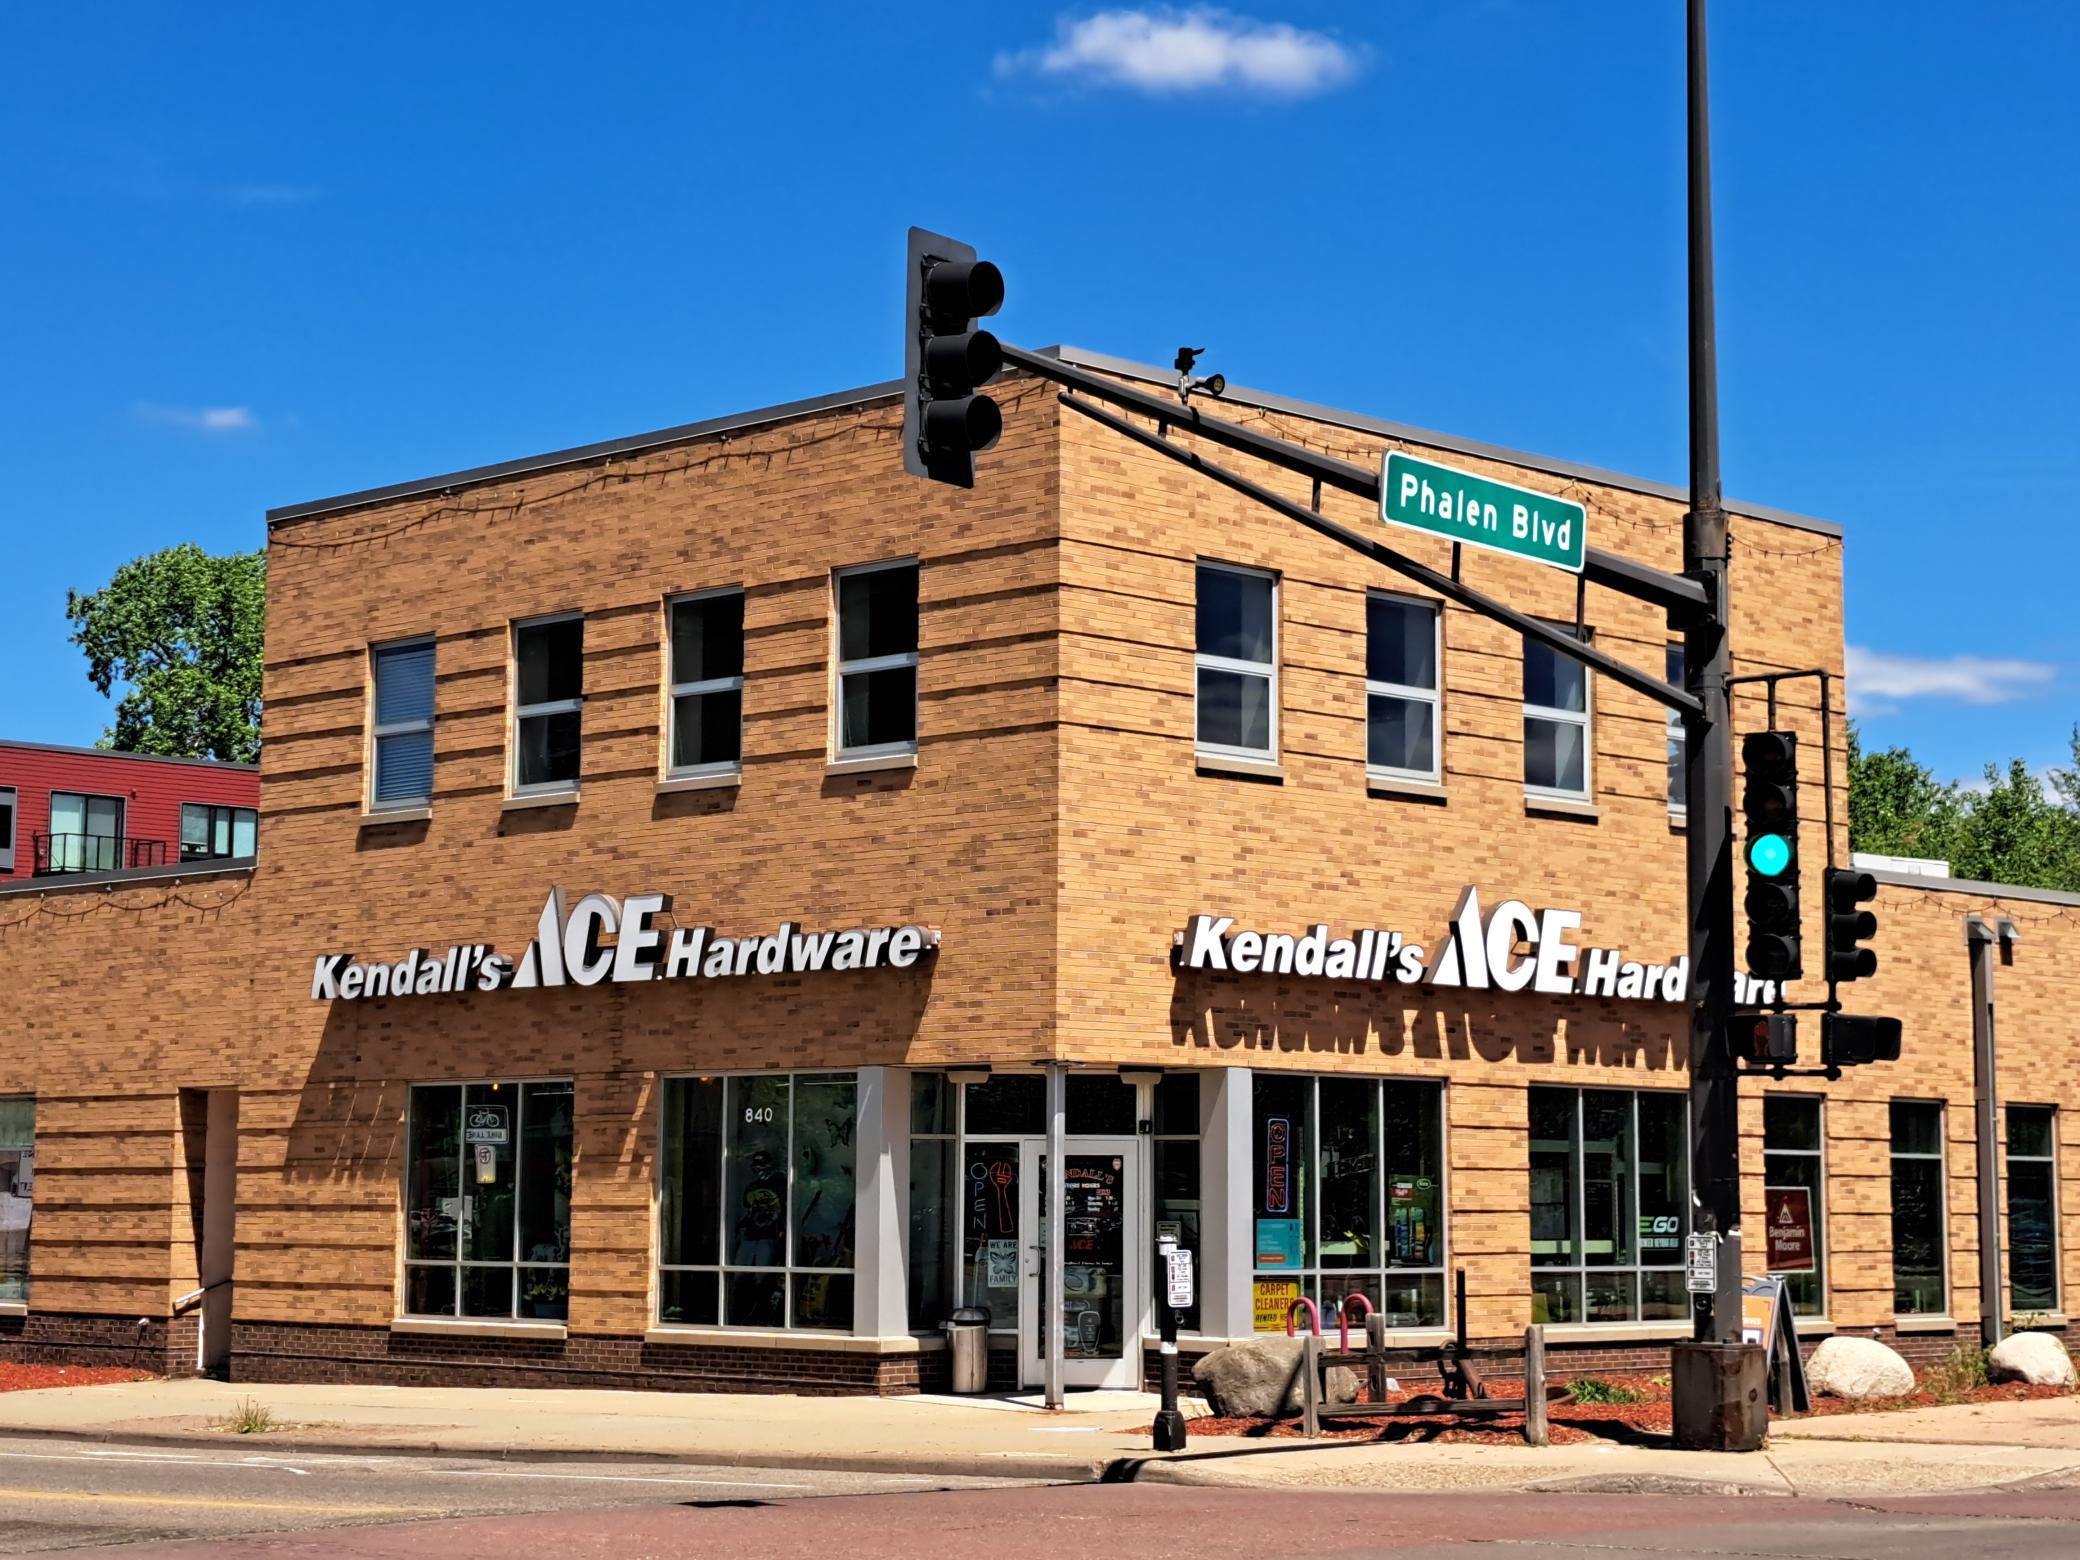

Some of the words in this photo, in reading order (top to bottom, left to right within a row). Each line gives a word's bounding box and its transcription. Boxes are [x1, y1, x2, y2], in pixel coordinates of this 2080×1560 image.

[1401, 472, 1498, 531] Phalen
[1512, 503, 1571, 551] Blvd
[312, 943, 507, 1001] Kendall's
[511, 885, 670, 989] ACE
[664, 921, 929, 979] Hardware
[1183, 913, 1424, 984] Kendall's
[1426, 884, 1582, 993] ACE
[1582, 948, 1787, 1005] Hardare
[745, 1107, 773, 1123] 840
[1269, 1123, 1287, 1208] OPEN
[970, 1162, 988, 1230] OPEN
[1639, 1215, 1679, 1234] EGO
[1768, 1226, 1806, 1240] Benjamin
[1003, 1240, 1017, 1249] ARE
[1774, 1239, 1801, 1251] Moore
[989, 1274, 1017, 1284] FAMILY
[1260, 1283, 1289, 1296] CARPET
